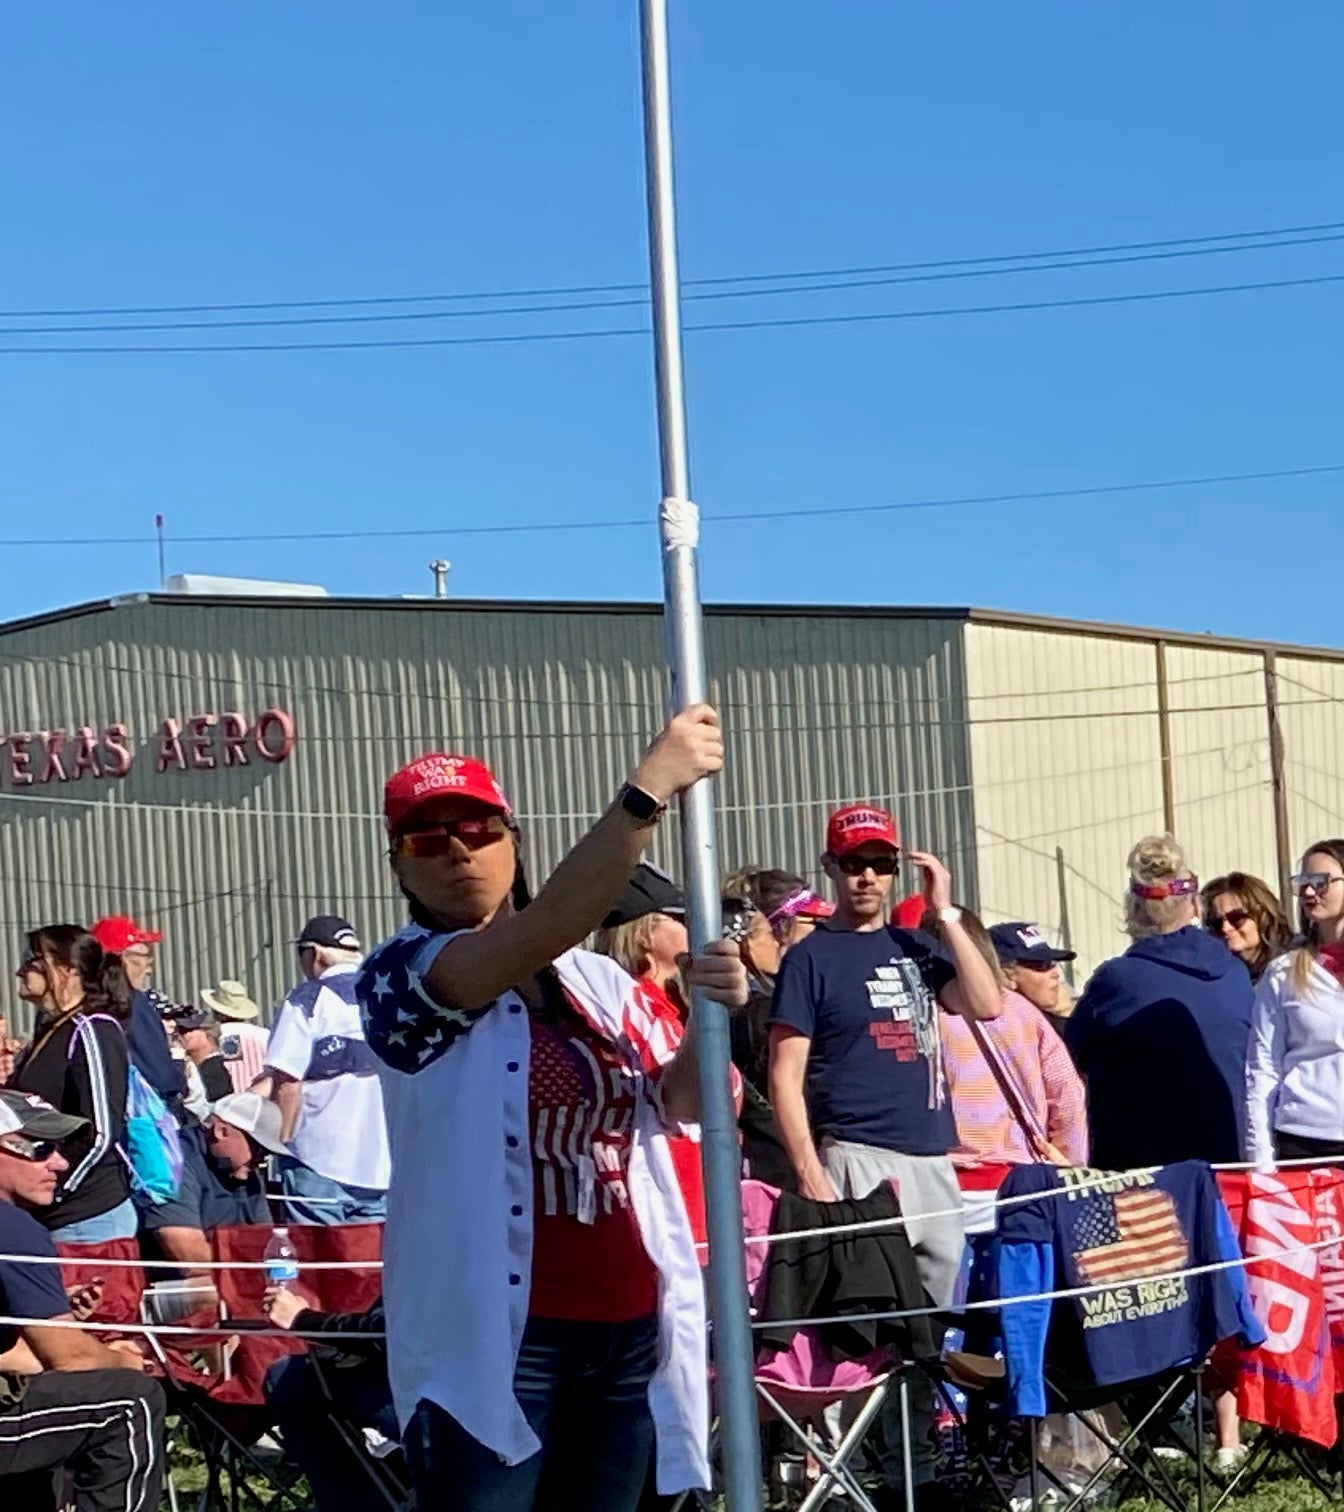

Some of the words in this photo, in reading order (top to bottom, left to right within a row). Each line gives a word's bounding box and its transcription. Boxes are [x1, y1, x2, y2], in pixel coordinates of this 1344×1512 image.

[0, 722, 134, 786] EXAS
[156, 706, 297, 771] AERO
[1080, 1287, 1133, 1317] WAS
[1083, 1309, 1124, 1330] ABOUT
